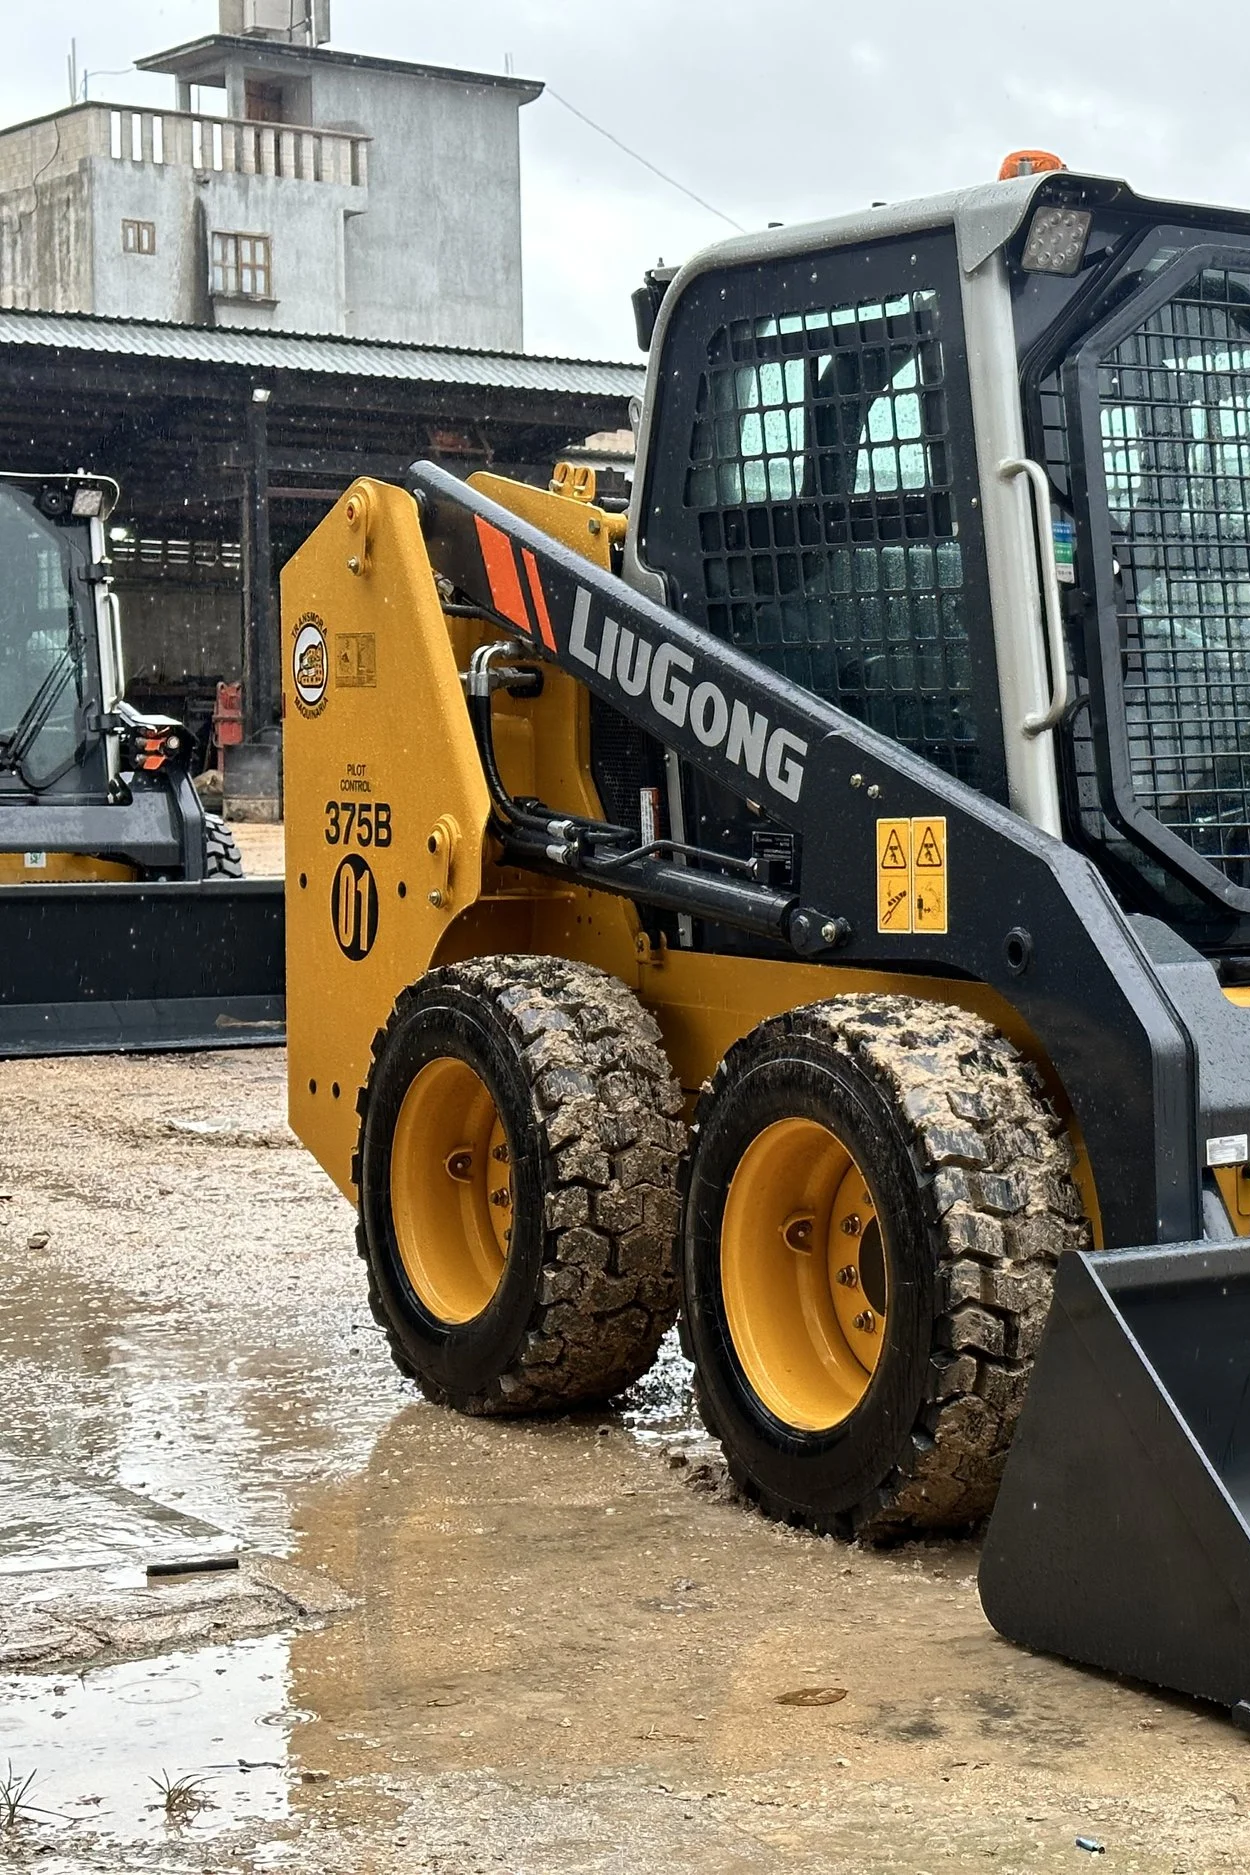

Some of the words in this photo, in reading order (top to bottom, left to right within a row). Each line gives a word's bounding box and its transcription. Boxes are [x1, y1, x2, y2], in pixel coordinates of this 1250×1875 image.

[291, 611, 328, 638] TRANSMORA
[568, 585, 809, 803] LIUGONG
[294, 696, 329, 720] MAQUINARIA
[346, 763, 367, 777] PILOT
[340, 779, 371, 793] CONTROL
[324, 800, 393, 848] 375B
[338, 862, 371, 952] 01
